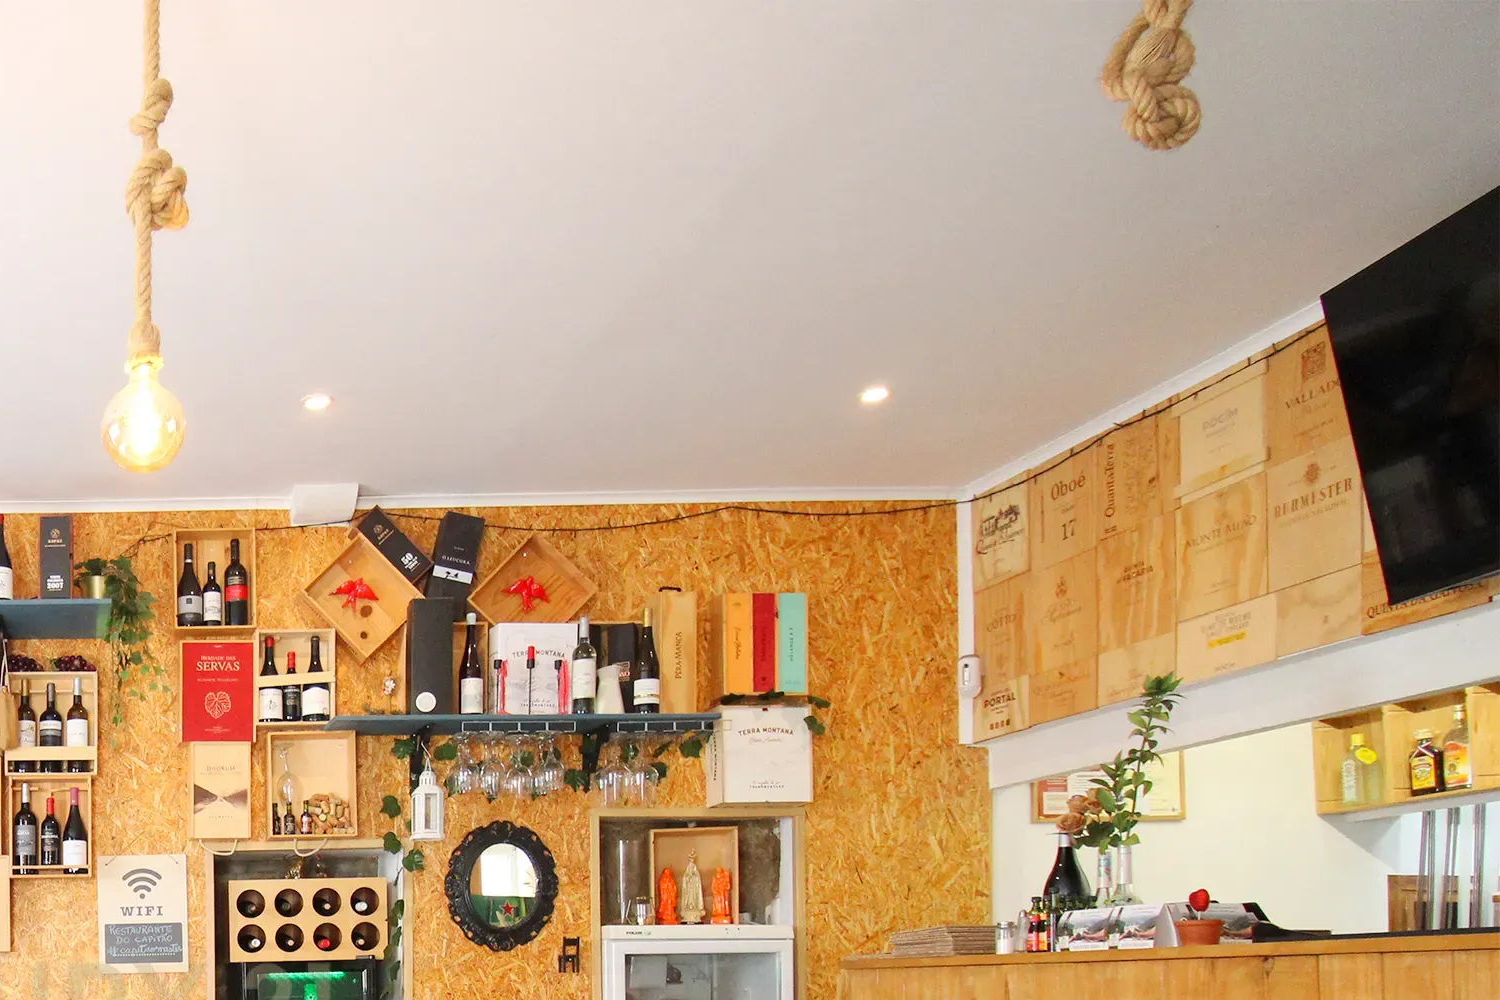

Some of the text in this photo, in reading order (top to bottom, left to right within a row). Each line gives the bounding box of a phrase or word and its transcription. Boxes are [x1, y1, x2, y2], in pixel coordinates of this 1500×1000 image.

[1061, 519, 1077, 541] 17
[400, 552, 414, 565] 50
[196, 661, 241, 672] SERVAS
[983, 692, 1017, 709] PORTAL
[738, 727, 795, 737] TERRA MONTANA
[120, 905, 164, 917] WIFI
[115, 935, 131, 945] DO
